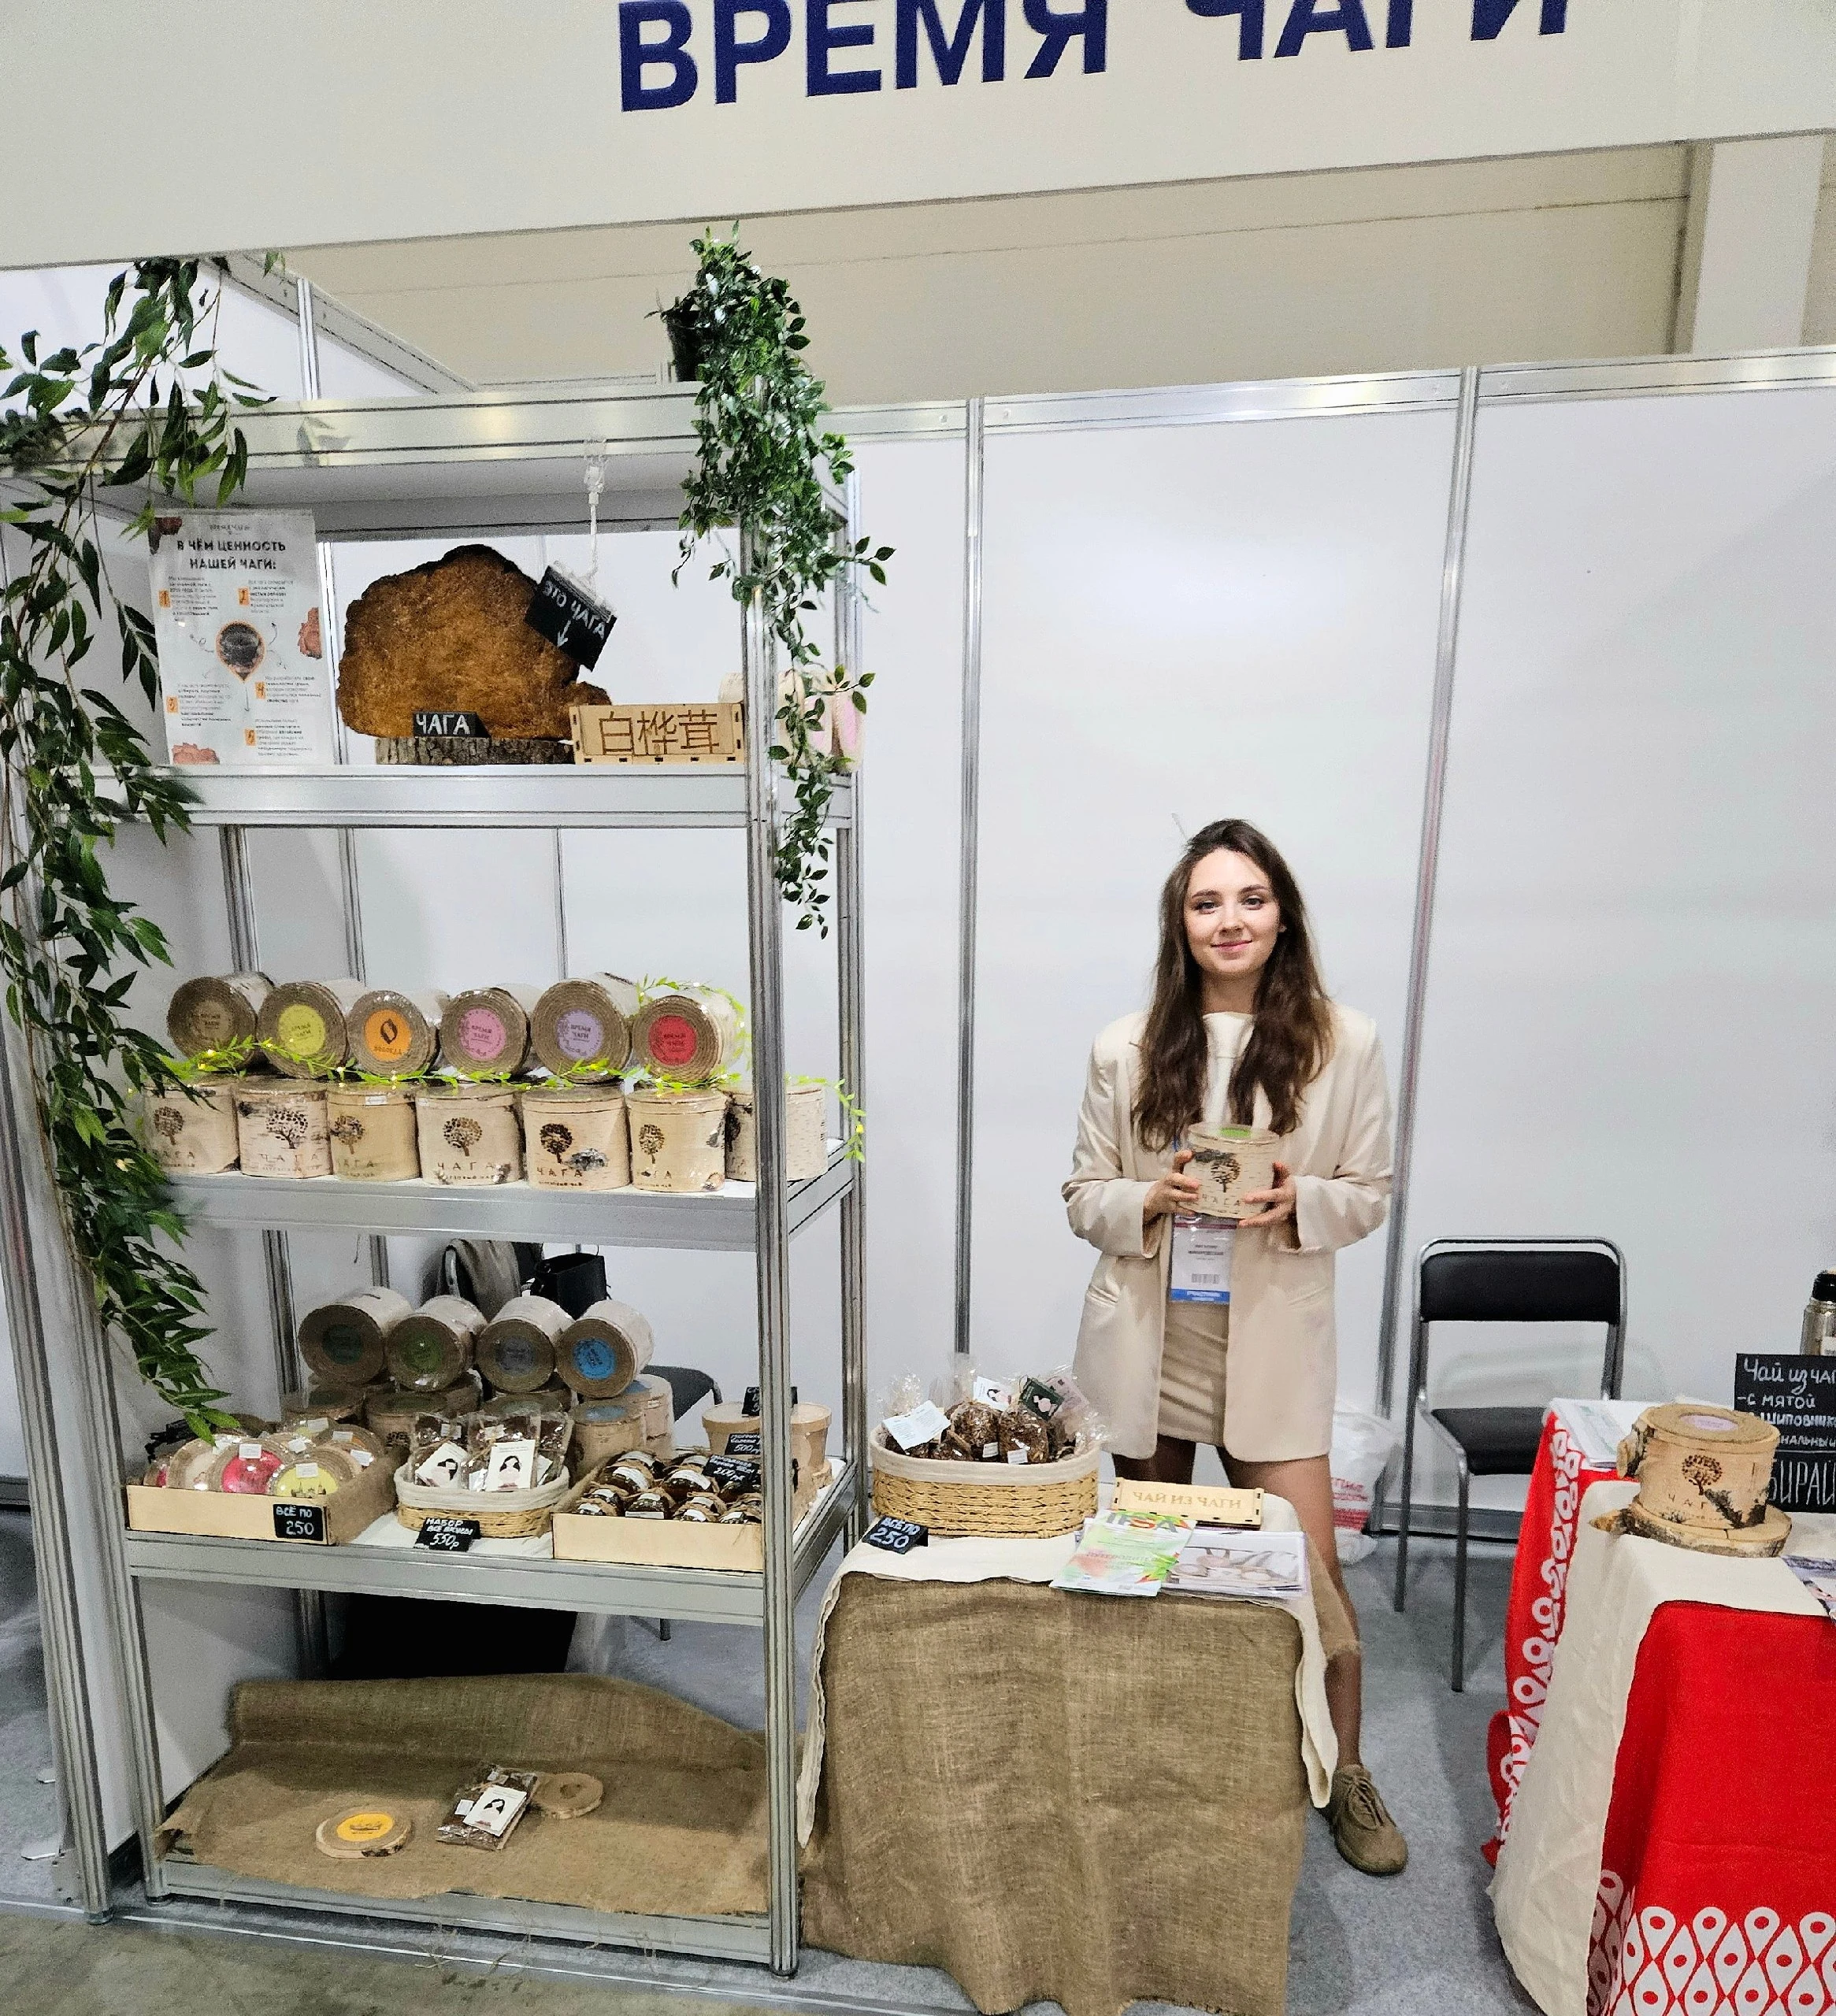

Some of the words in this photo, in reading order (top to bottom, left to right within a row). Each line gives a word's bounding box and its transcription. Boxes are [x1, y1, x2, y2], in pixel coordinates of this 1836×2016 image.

[619, 0, 1107, 112] ВРЕМЯ
[177, 540, 184, 550] В
[188, 538, 213, 550] ЧЁМ
[217, 540, 286, 552] ЦЕННОСТЬ
[190, 556, 236, 569] НАШЕЙ
[239, 557, 276, 569] ЧАГИ:
[571, 600, 605, 640] ЧАГА
[415, 713, 471, 735] ЧАГА
[599, 709, 719, 755] 白桦茸
[438, 1162, 494, 1170] ЧАГА
[536, 1167, 583, 1177] ЧАГА
[1744, 1358, 1784, 1382] Чай
[1788, 1369, 1808, 1395] из
[1133, 1492, 1167, 1503] ЧАЙ
[1170, 1495, 1192, 1505] ИЗ
[1197, 1496, 1242, 1509] ЧАГИ
[1668, 1493, 1708, 1510] ЧАГ
[299, 1508, 313, 1518] ПО
[286, 1521, 314, 1536] 250
[425, 1518, 464, 1528] НАБОР
[901, 1523, 921, 1536] ПО
[870, 1527, 910, 1548] 250
